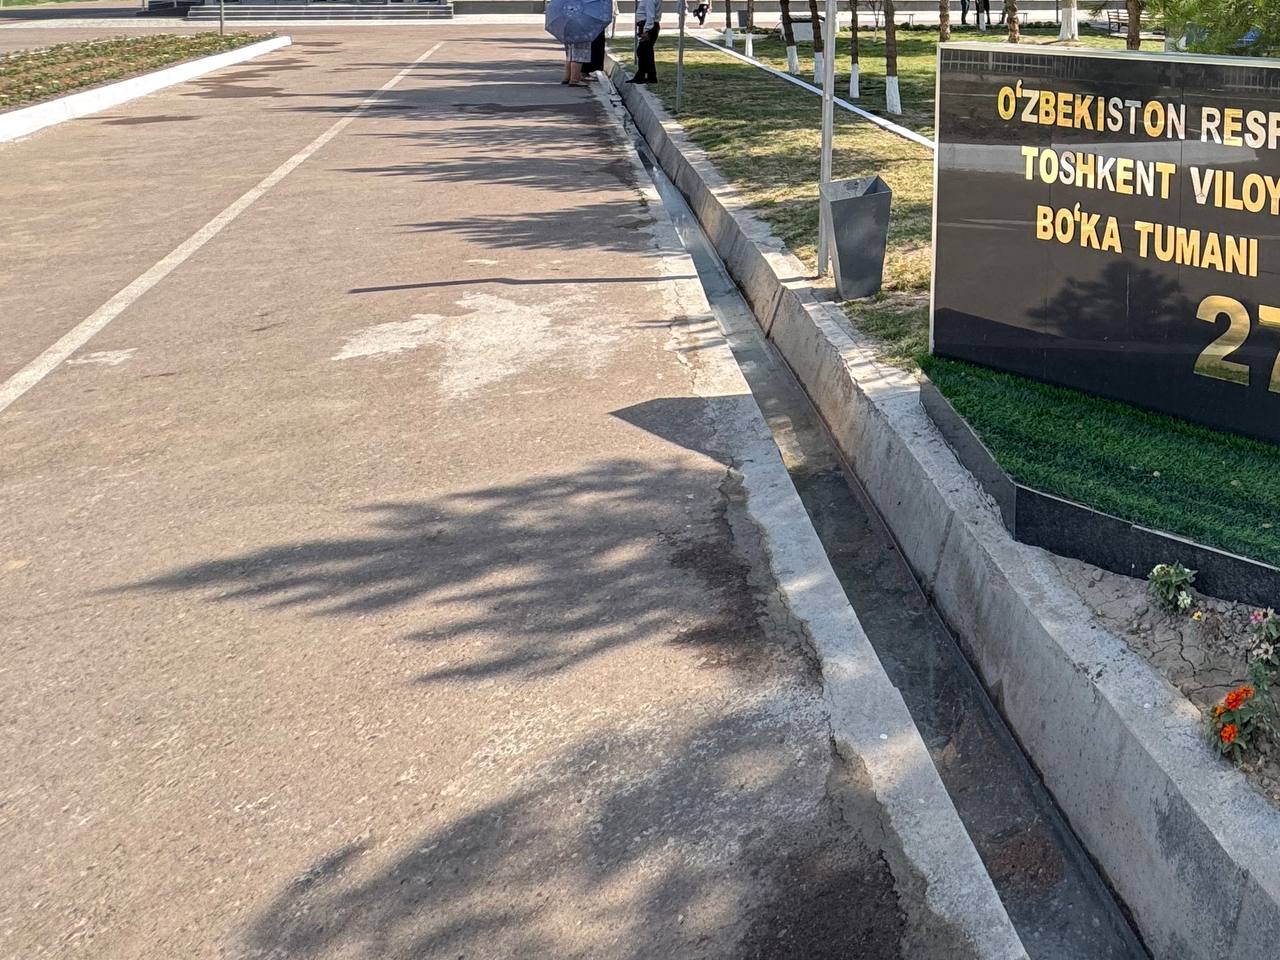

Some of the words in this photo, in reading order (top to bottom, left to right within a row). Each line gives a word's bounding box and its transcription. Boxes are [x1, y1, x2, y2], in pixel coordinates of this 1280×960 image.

[997, 80, 1186, 139] O‘ZBEKISTON
[1021, 145, 1176, 199] TOSHKENT
[1036, 201, 1122, 253] BO‘KA
[1134, 220, 1258, 276] TUMANI
